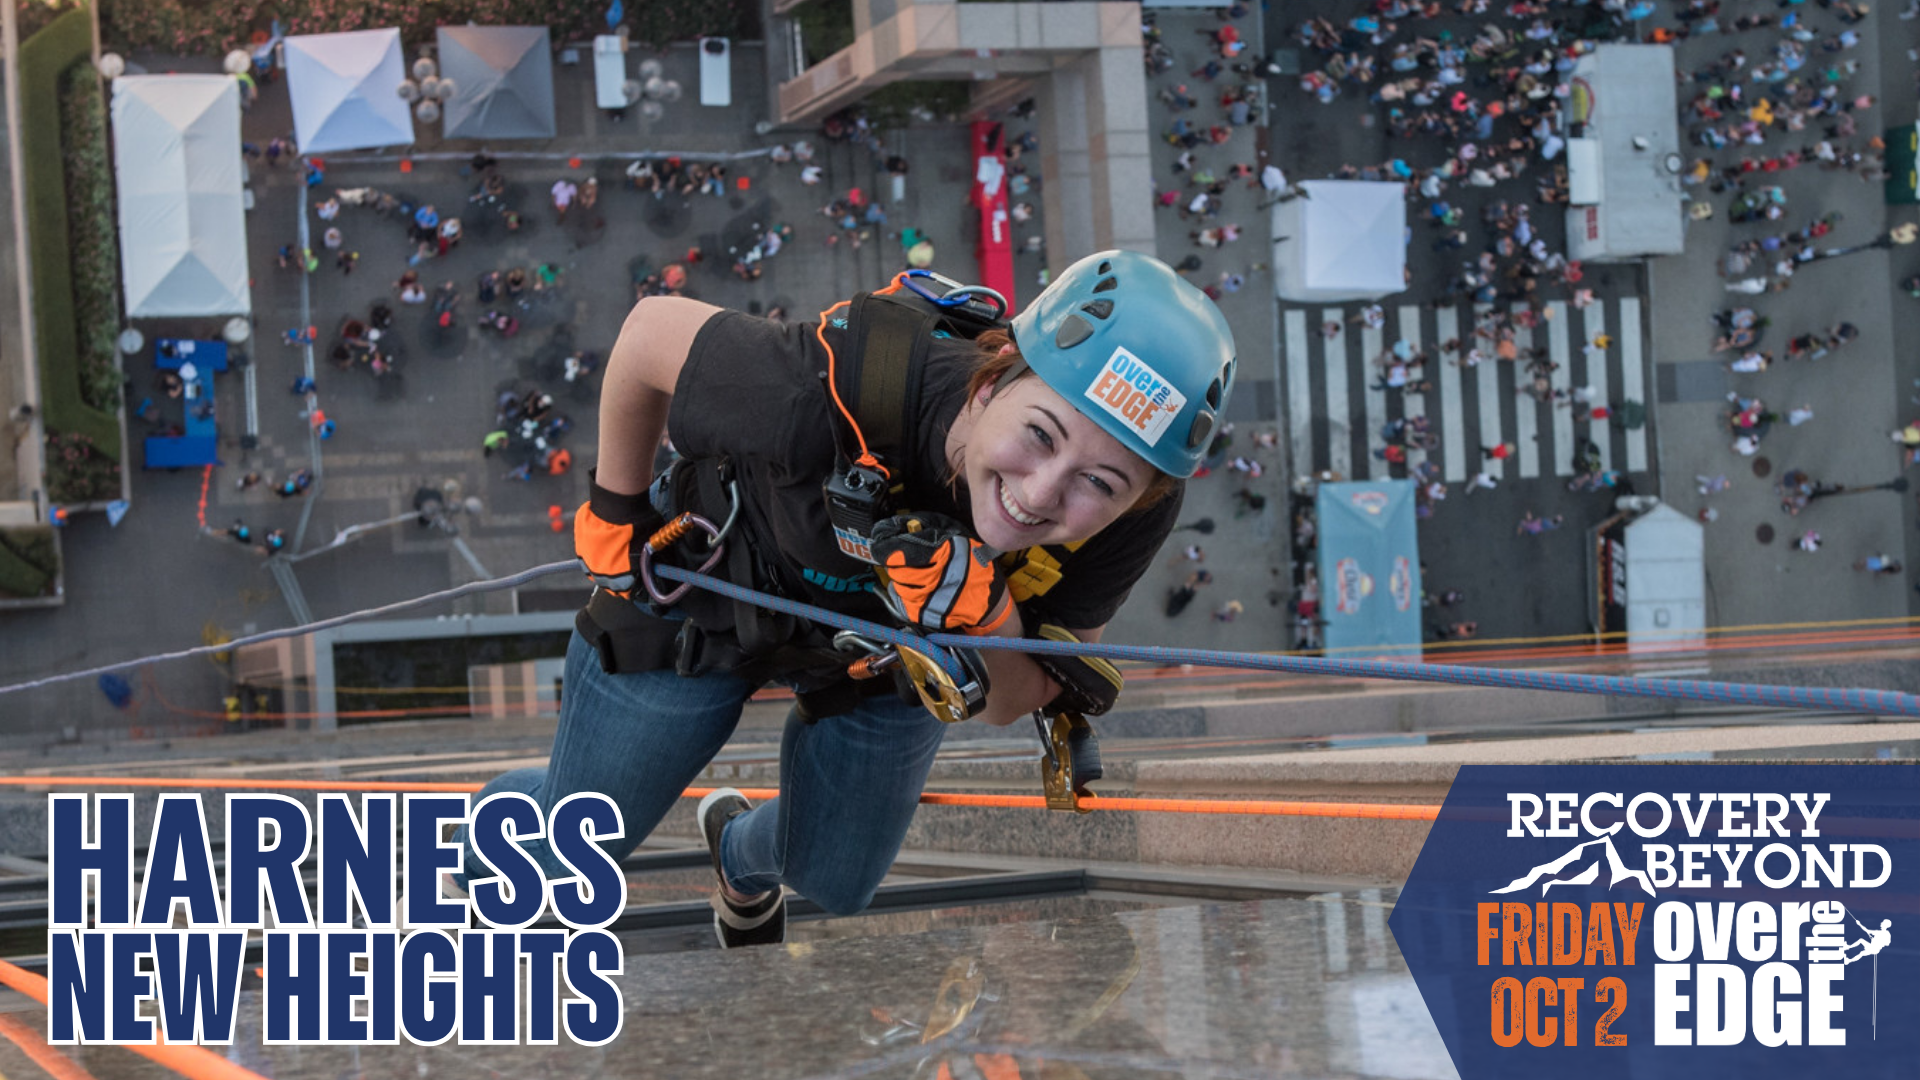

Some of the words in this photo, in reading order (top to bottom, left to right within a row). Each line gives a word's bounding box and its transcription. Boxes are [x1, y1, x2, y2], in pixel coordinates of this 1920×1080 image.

[1111, 354, 1162, 398] over
[1152, 386, 1171, 407] the
[1092, 369, 1159, 430] EDGE
